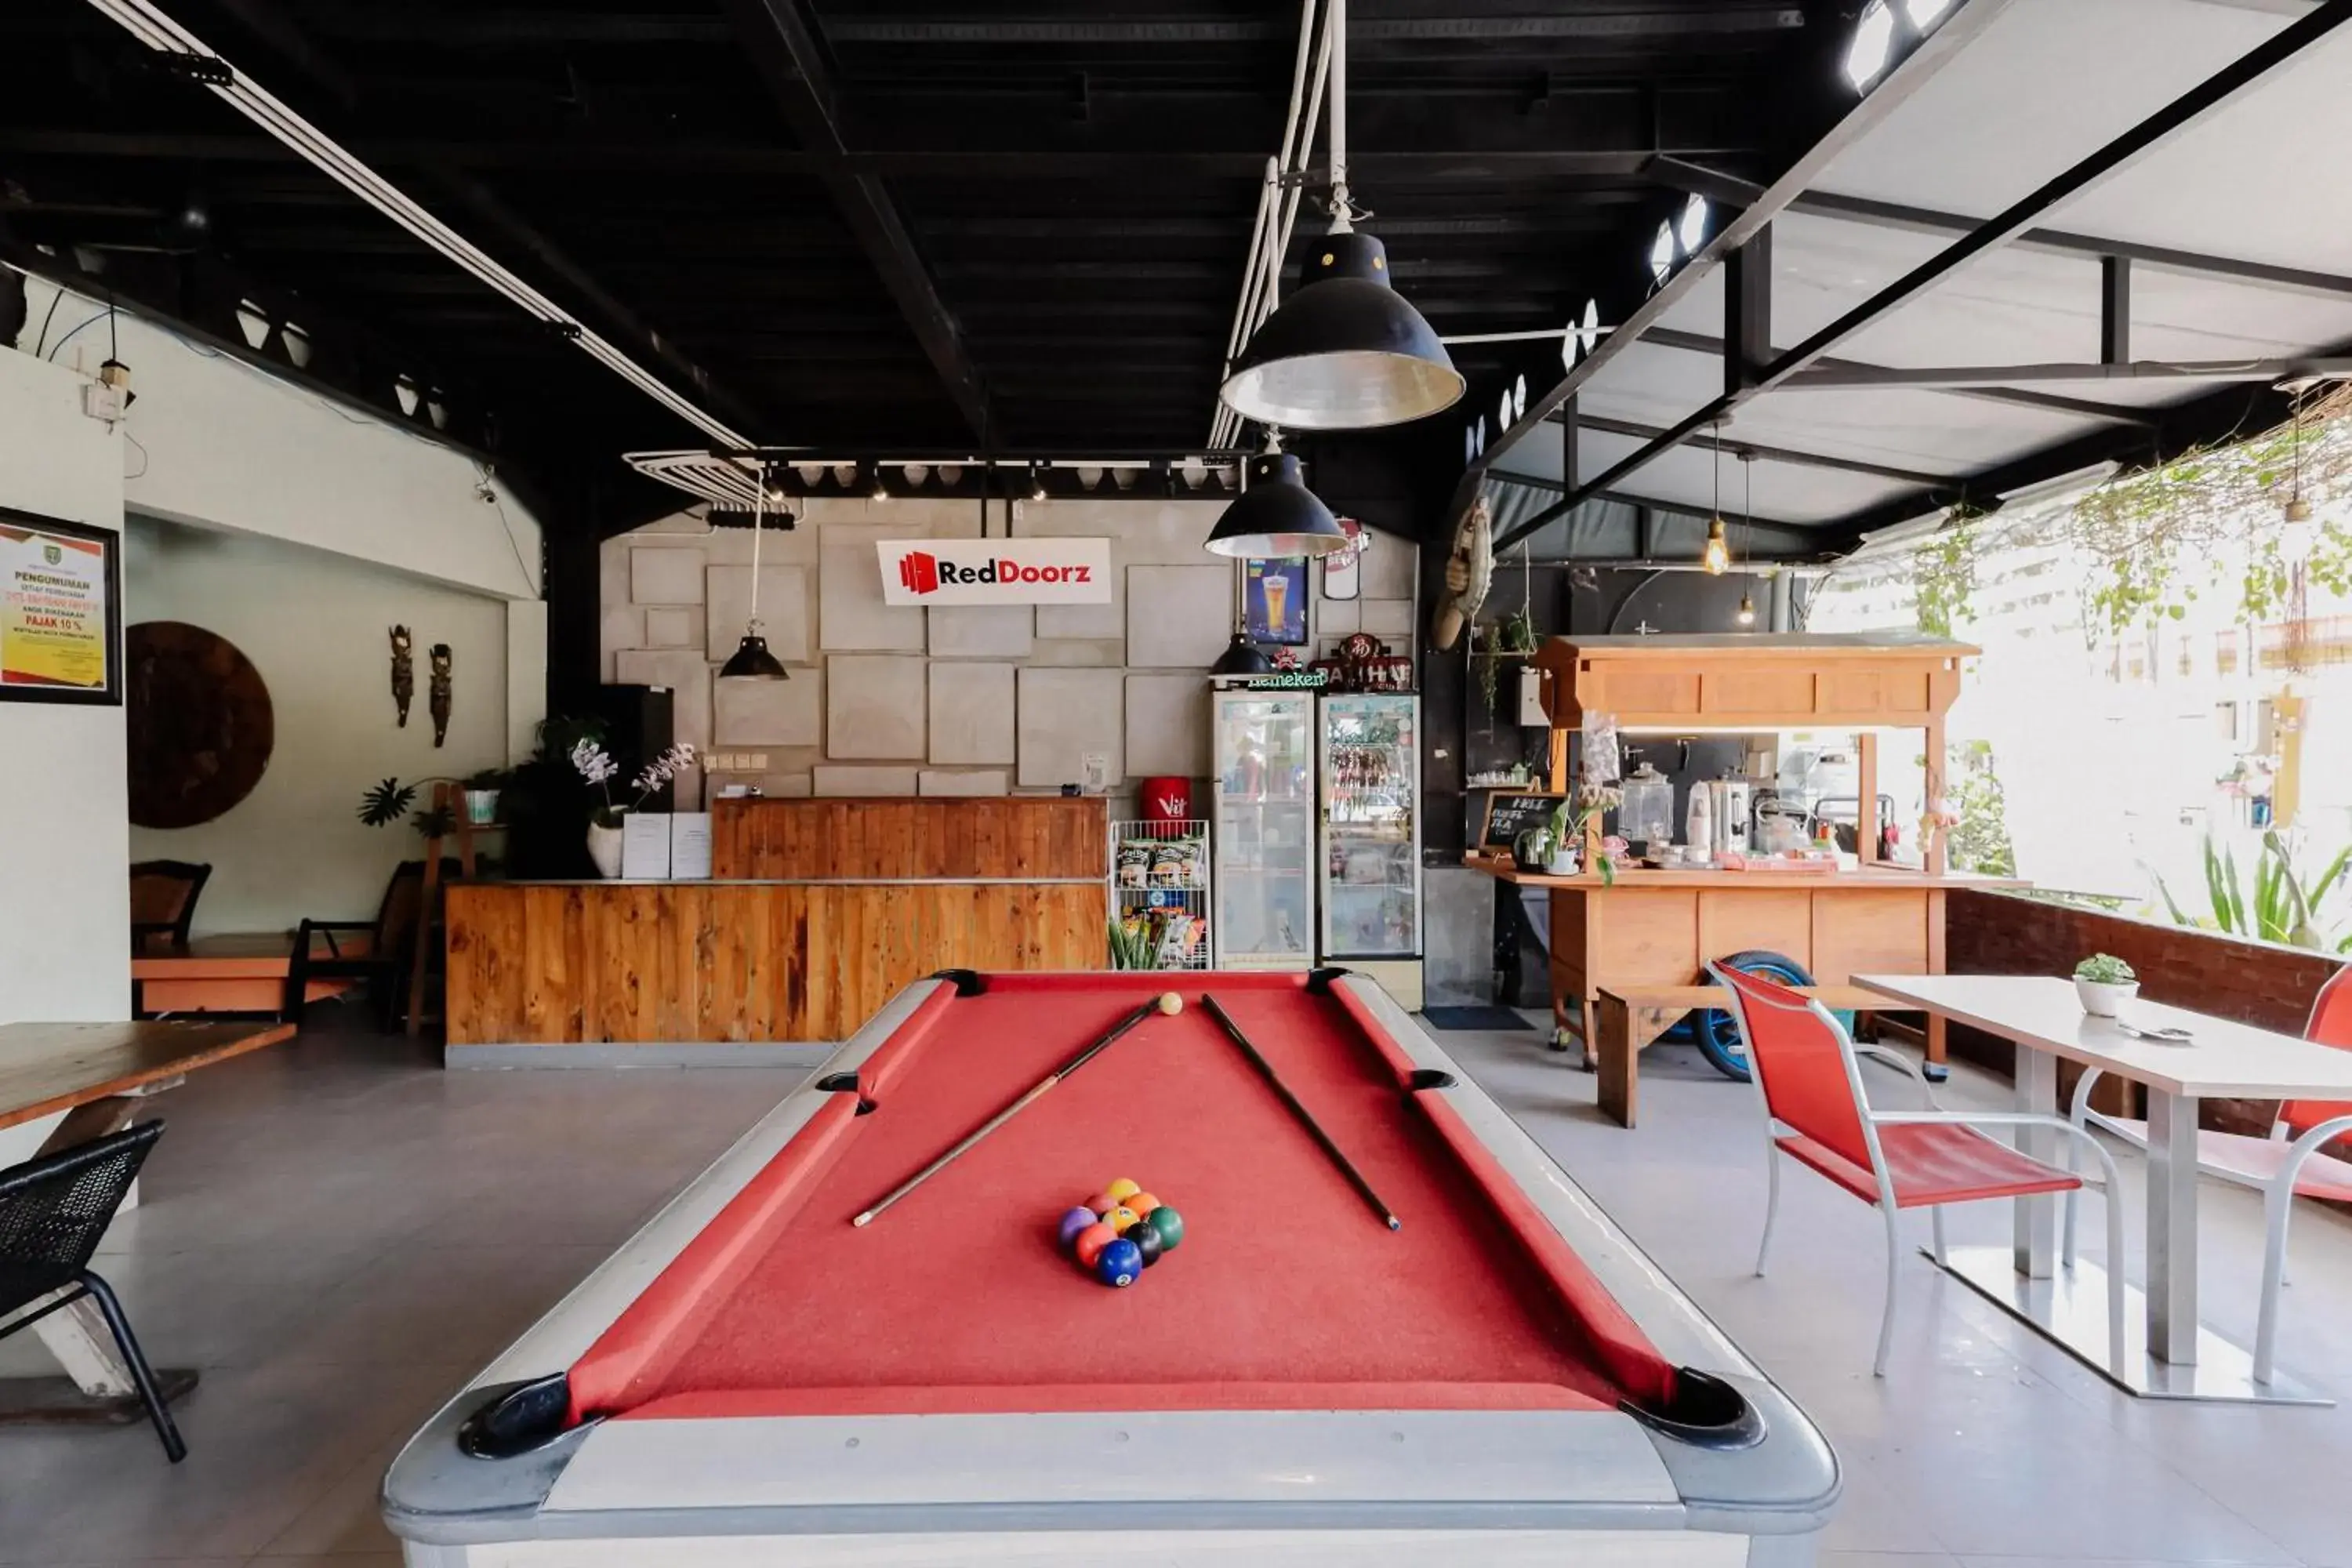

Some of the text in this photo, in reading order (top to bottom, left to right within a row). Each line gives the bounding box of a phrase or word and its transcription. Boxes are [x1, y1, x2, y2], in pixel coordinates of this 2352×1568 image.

[14, 571, 90, 590] PENGUMUMAN
[938, 558, 1091, 584] RedDoorz
[25, 615, 58, 628] PAJAK
[60, 619, 71, 630] 10
